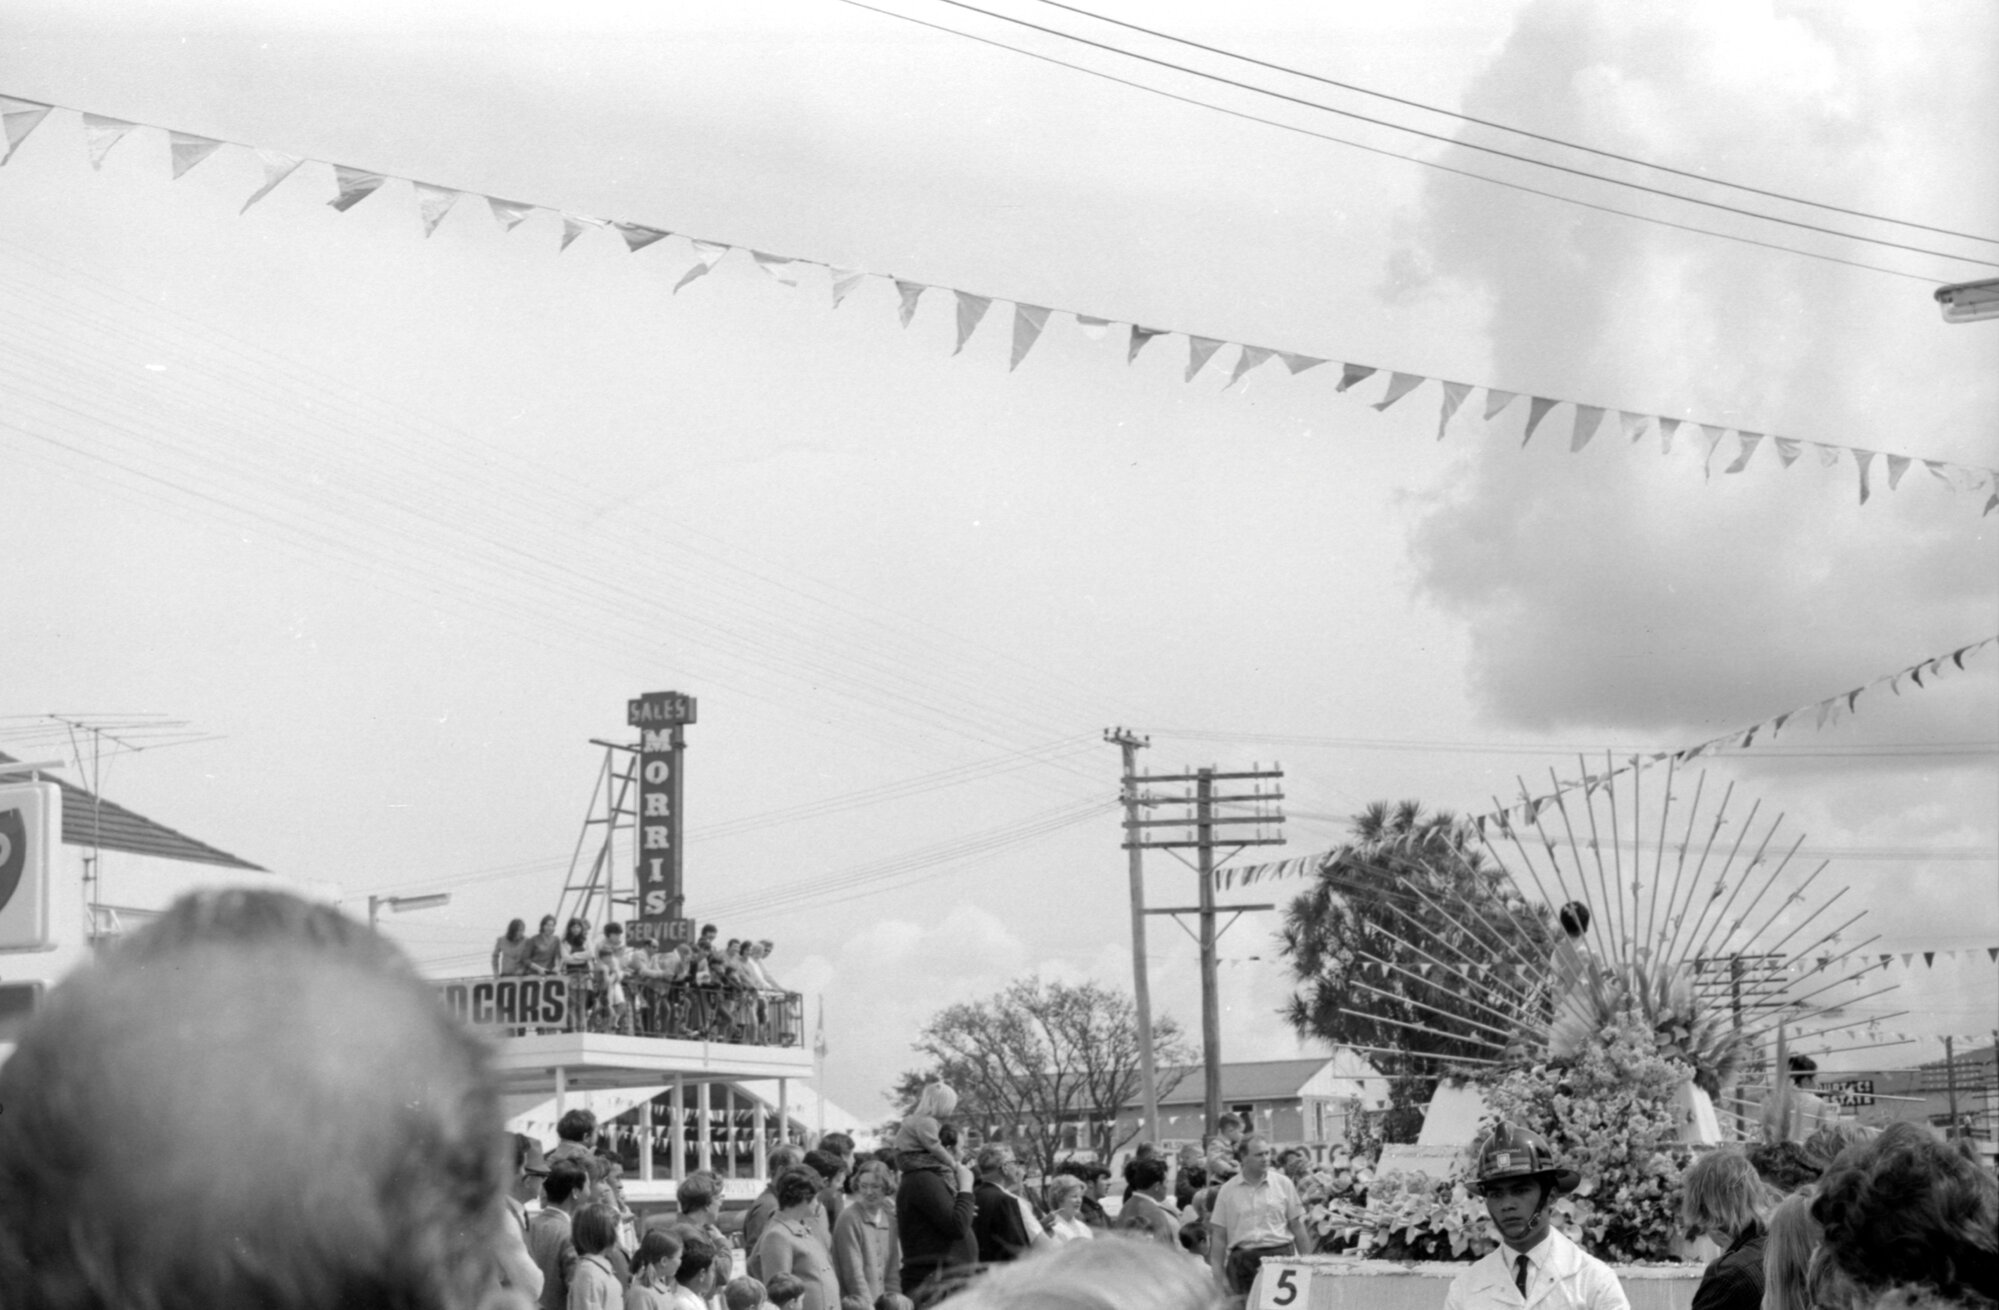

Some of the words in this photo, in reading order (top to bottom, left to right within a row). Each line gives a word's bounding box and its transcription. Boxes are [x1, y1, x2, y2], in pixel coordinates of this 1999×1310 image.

[631, 698, 686, 722] SALES
[643, 728, 673, 915] MORRIS
[626, 921, 687, 942] SERVICE
[473, 980, 565, 1024] CARS
[1273, 1269, 1298, 1306] 5
